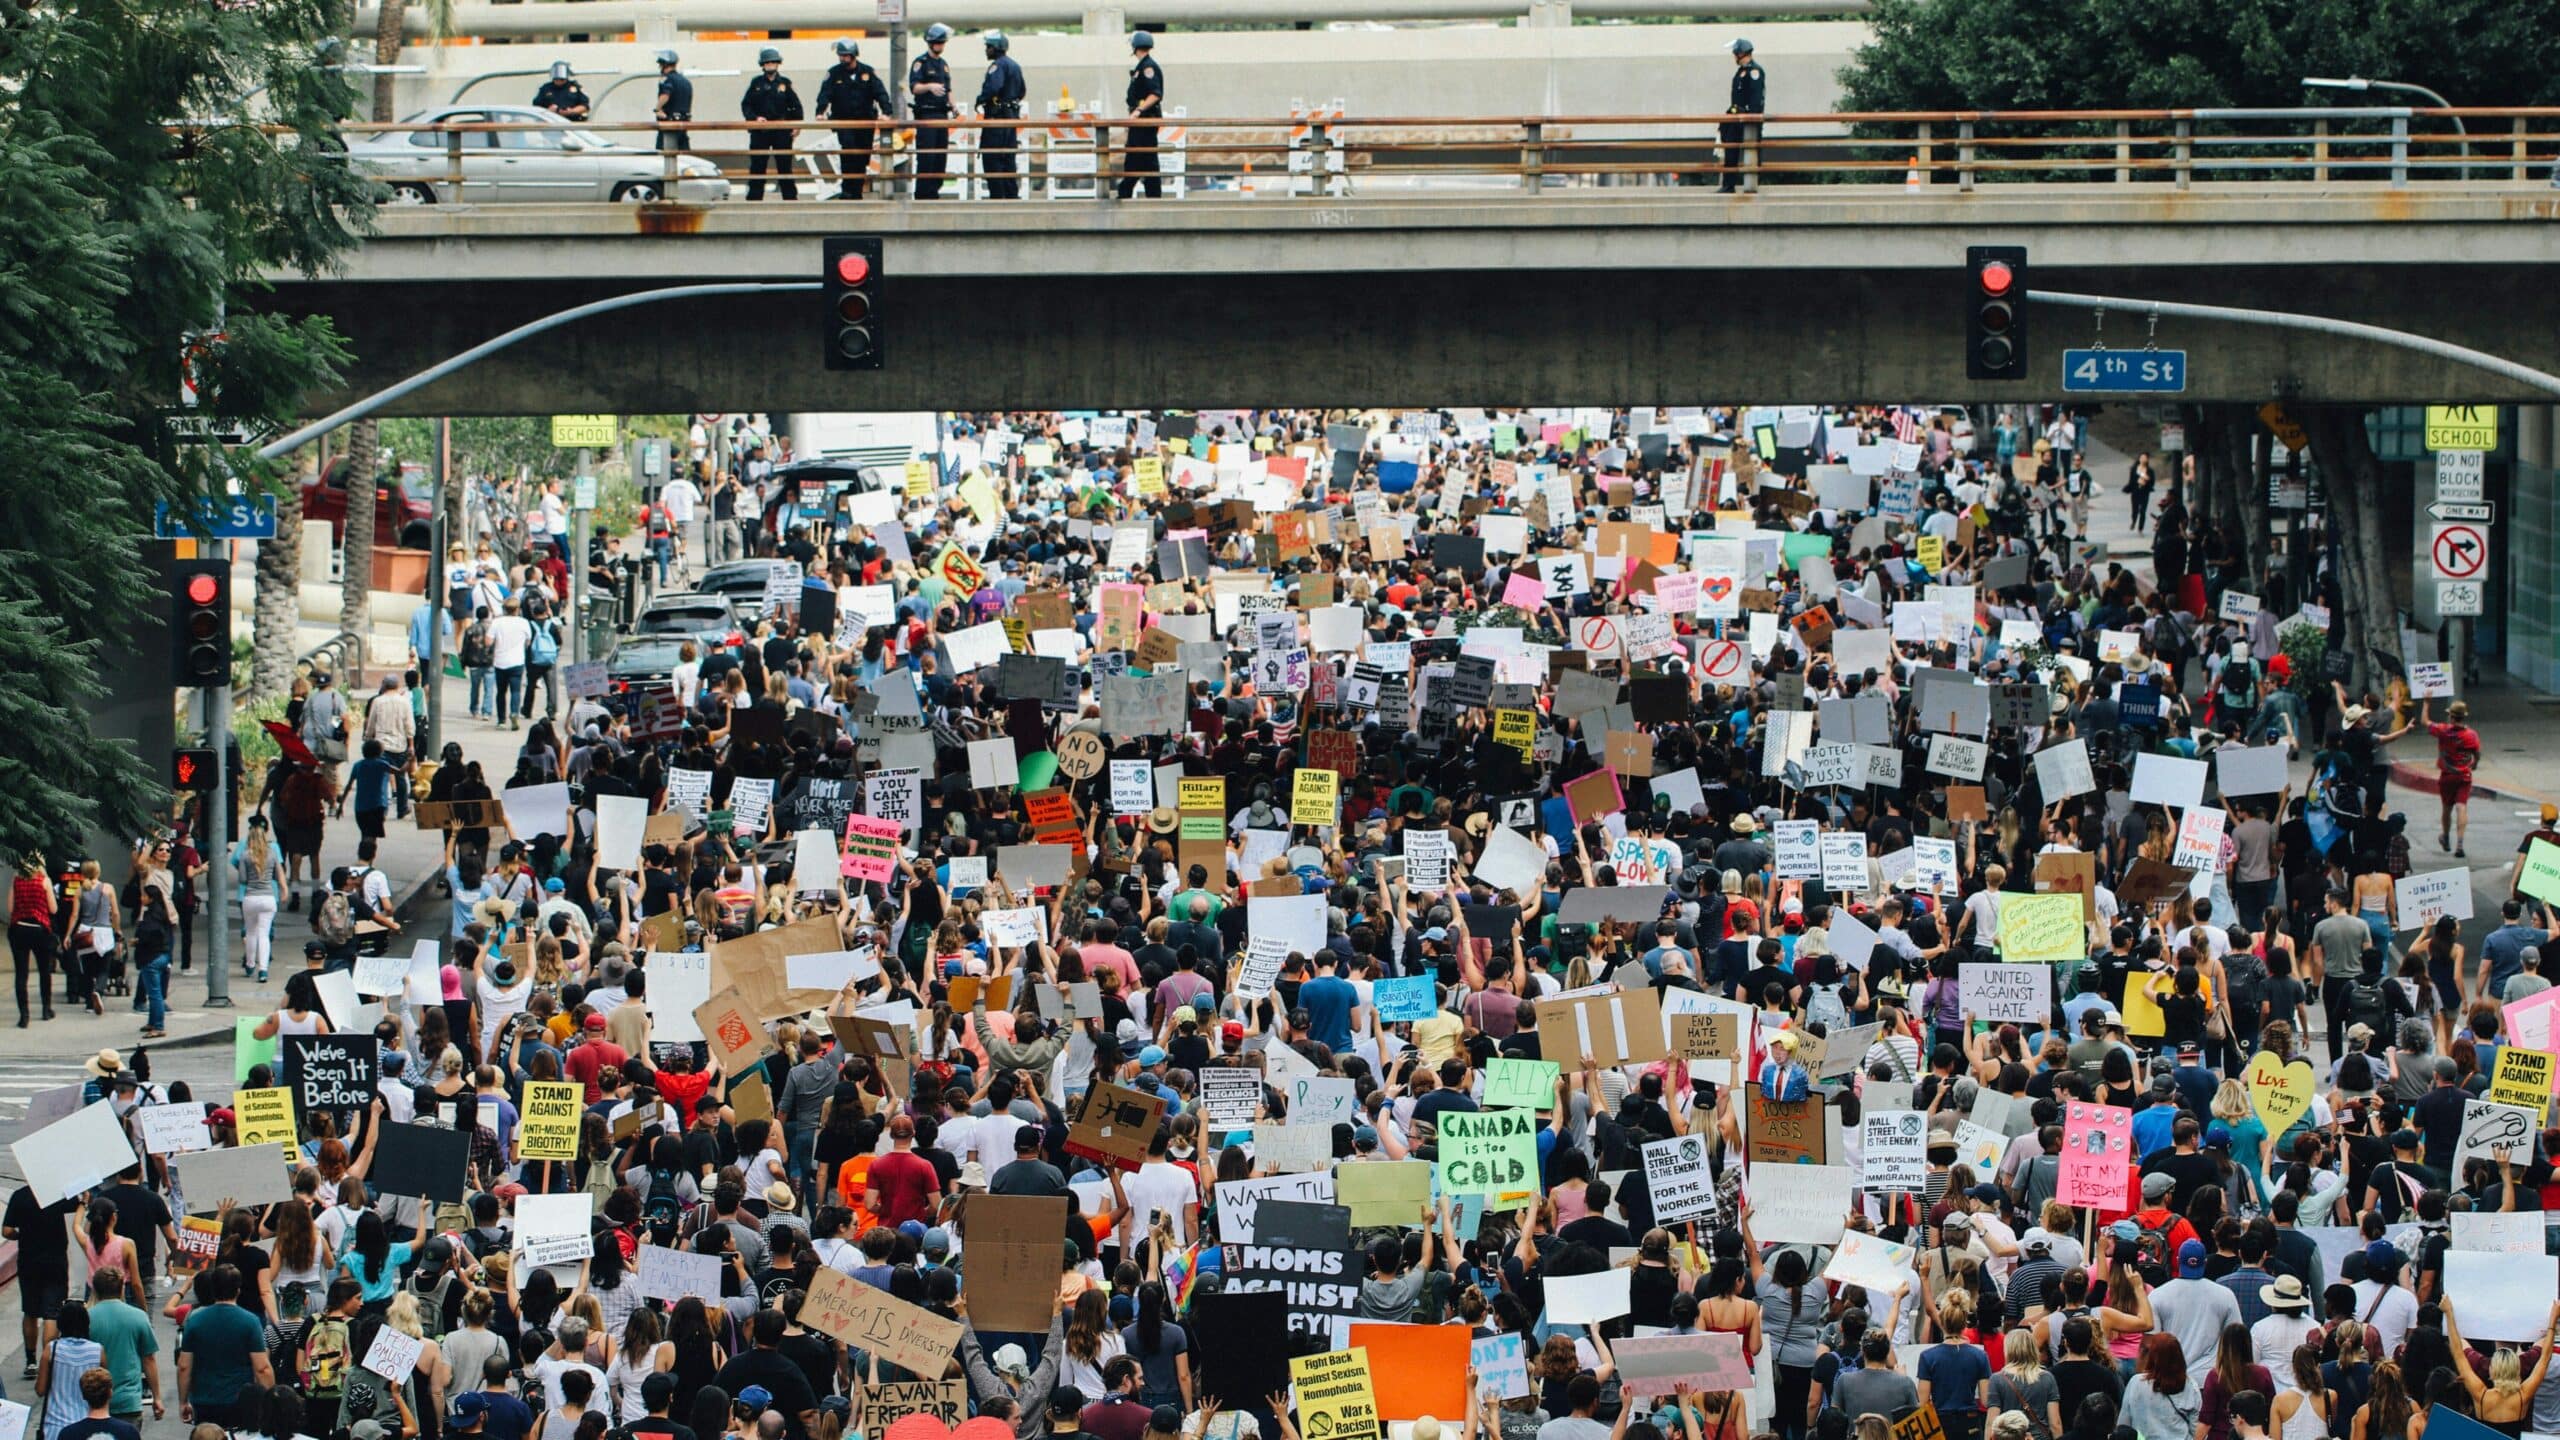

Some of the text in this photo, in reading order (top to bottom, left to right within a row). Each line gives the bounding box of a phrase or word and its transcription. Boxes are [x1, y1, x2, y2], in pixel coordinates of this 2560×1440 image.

[2074, 358, 2173, 382] 4th St
[558, 428, 611, 441] SCHOOL
[2431, 430, 2491, 448] SCHOOL
[2440, 454, 2480, 467] DO NOT
[2440, 472, 2480, 485] BLOCK
[2439, 489, 2480, 497] INTERSECTION
[231, 504, 264, 528] St
[2445, 506, 2486, 516] ONE WAY
[1240, 595, 1285, 609] OBSTRUCT
[2414, 665, 2438, 674] HATE
[2123, 702, 2156, 715] THINK
[864, 715, 919, 729] 4 YEARS
[1502, 712, 1530, 724] STAND
[1500, 722, 1530, 735] AGAINST
[1068, 736, 1097, 754] NO
[1311, 732, 1353, 747] CIVIL
[1804, 744, 1855, 761] PROTECT
[1943, 742, 1975, 755] NO HATE
[1058, 752, 1093, 778] DAPL
[1817, 759, 1841, 768] YOUR
[1953, 754, 1976, 766] TRUMP
[865, 768, 920, 779] DEAR TRUMP
[1301, 774, 1330, 783] STAND
[1808, 767, 1852, 785] PUSSY
[1880, 766, 1896, 778] BAD
[809, 779, 841, 799] Hate
[878, 778, 907, 789] YOU
[1182, 783, 1222, 793] Hillary
[1299, 783, 1331, 794] AGAINST
[873, 788, 912, 801] CAN'T
[1030, 796, 1061, 807] TRUMP
[795, 795, 853, 815] NEVER MADE
[881, 800, 905, 810] SIT
[877, 810, 909, 820] WITH
[1797, 852, 1811, 860] THE
[1825, 848, 1846, 856] FIGHT
[1779, 862, 1818, 871] WORKERS
[1825, 864, 1858, 872] FOR THE
[2177, 852, 2212, 873] HATE
[1827, 874, 1866, 882] WORKERS
[2413, 881, 2447, 895] UNITED
[2420, 905, 2443, 917] HATE
[1984, 969, 2033, 985] UNITED
[1381, 989, 1423, 1003] SURVIVING
[1974, 985, 2035, 1001] AGAINST
[1988, 1002, 2027, 1019] HATE
[1691, 1015, 1713, 1026] END
[1687, 1027, 1718, 1038] HATE
[1689, 1039, 1717, 1047] DUMP
[296, 1041, 346, 1062] We've
[1683, 1048, 1720, 1057] TRUMP
[2506, 1052, 2546, 1070] STAND
[303, 1058, 369, 1081] Seen It
[2500, 1067, 2546, 1086] AGAINST
[1493, 1062, 1557, 1096] ALLY
[2256, 1068, 2289, 1089] LOVE
[304, 1080, 369, 1107] Before
[533, 1086, 573, 1101] STAND
[1207, 1090, 1256, 1099] NEGAMOS
[2271, 1089, 2300, 1108] trumps
[2493, 1087, 2547, 1105] ANTI-MUSLIM
[529, 1102, 574, 1117] AGAINST
[2267, 1099, 2289, 1115] hate
[2467, 1104, 2495, 1121] SAFE
[523, 1123, 577, 1136] ANTI-MUSLIM
[1443, 1114, 1531, 1138] CANADA
[1868, 1117, 1890, 1127] WALL
[1768, 1120, 1803, 1140] ASS
[1867, 1127, 1897, 1137] STREET
[526, 1136, 571, 1150] BIGOTRY!
[1464, 1140, 1506, 1156] is too
[1867, 1138, 1874, 1147] IS
[1876, 1138, 1888, 1146] THE
[2491, 1136, 2527, 1151] PLACE
[1646, 1146, 1671, 1159] WALL
[1760, 1147, 1774, 1156] BAD
[1648, 1155, 1679, 1170] STREET
[1885, 1156, 1924, 1165] MUSLIMS
[1447, 1158, 1525, 1186] COLD
[1650, 1171, 1658, 1180] IS
[1659, 1167, 1672, 1178] THE
[1887, 1165, 1899, 1173] OR
[2070, 1163, 2119, 1179] NOT MY
[1865, 1173, 1923, 1182] IMMIGRANTS
[1654, 1181, 1699, 1199] FOR THE
[1657, 1193, 1711, 1213] WORKERS
[179, 1228, 221, 1244] DONALD
[643, 1251, 700, 1273] ANGRY
[1243, 1246, 1344, 1275] MOMS
[642, 1268, 718, 1295] FEMINIST
[813, 1287, 953, 1359] AMERICA IS DIVERSITY
[379, 1346, 404, 1366] MUST
[1304, 1352, 1352, 1372] Fight Back
[376, 1360, 395, 1378] GO
[1296, 1371, 1331, 1388] Against
[864, 1381, 956, 1404] WE WANT
[920, 1400, 961, 1425] FAIR
[1341, 1403, 1373, 1419] War &
[1335, 1418, 1376, 1436] Racism
